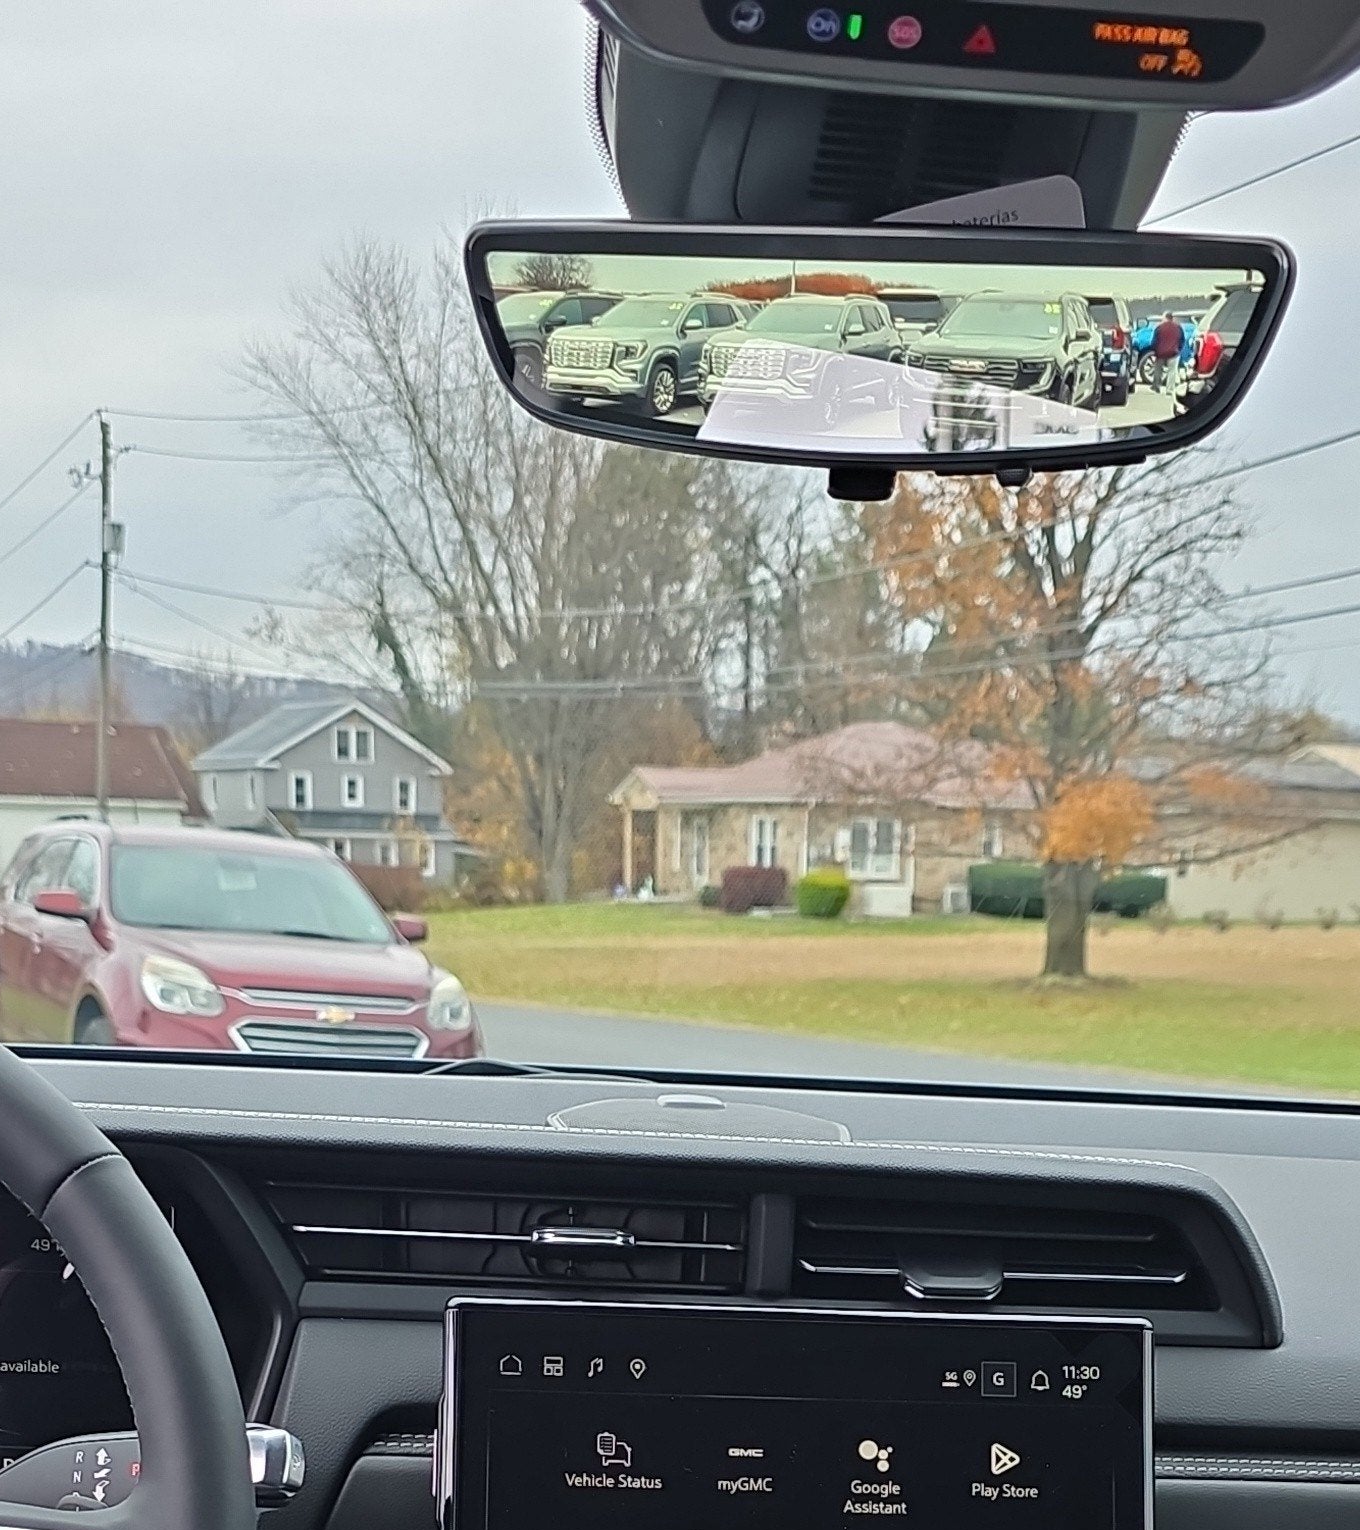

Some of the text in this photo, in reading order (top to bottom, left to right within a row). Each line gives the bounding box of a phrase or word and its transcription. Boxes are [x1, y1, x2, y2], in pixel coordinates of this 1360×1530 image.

[1094, 23, 1190, 46] PASS AIR BAG
[1140, 53, 1168, 72] OFF
[992, 1372, 1005, 1386] G
[1062, 1365, 1100, 1380] 11:30
[1061, 1384, 1088, 1399] 49°
[75, 1451, 84, 1463] R
[728, 1448, 764, 1457] GMC
[73, 1471, 82, 1483] N
[132, 1463, 141, 1476] P
[565, 1473, 662, 1489] Vehicle Status
[717, 1478, 773, 1494] myGMC
[851, 1480, 901, 1498] Google
[972, 1483, 1039, 1500] Play Store
[843, 1500, 907, 1515] Assistant
